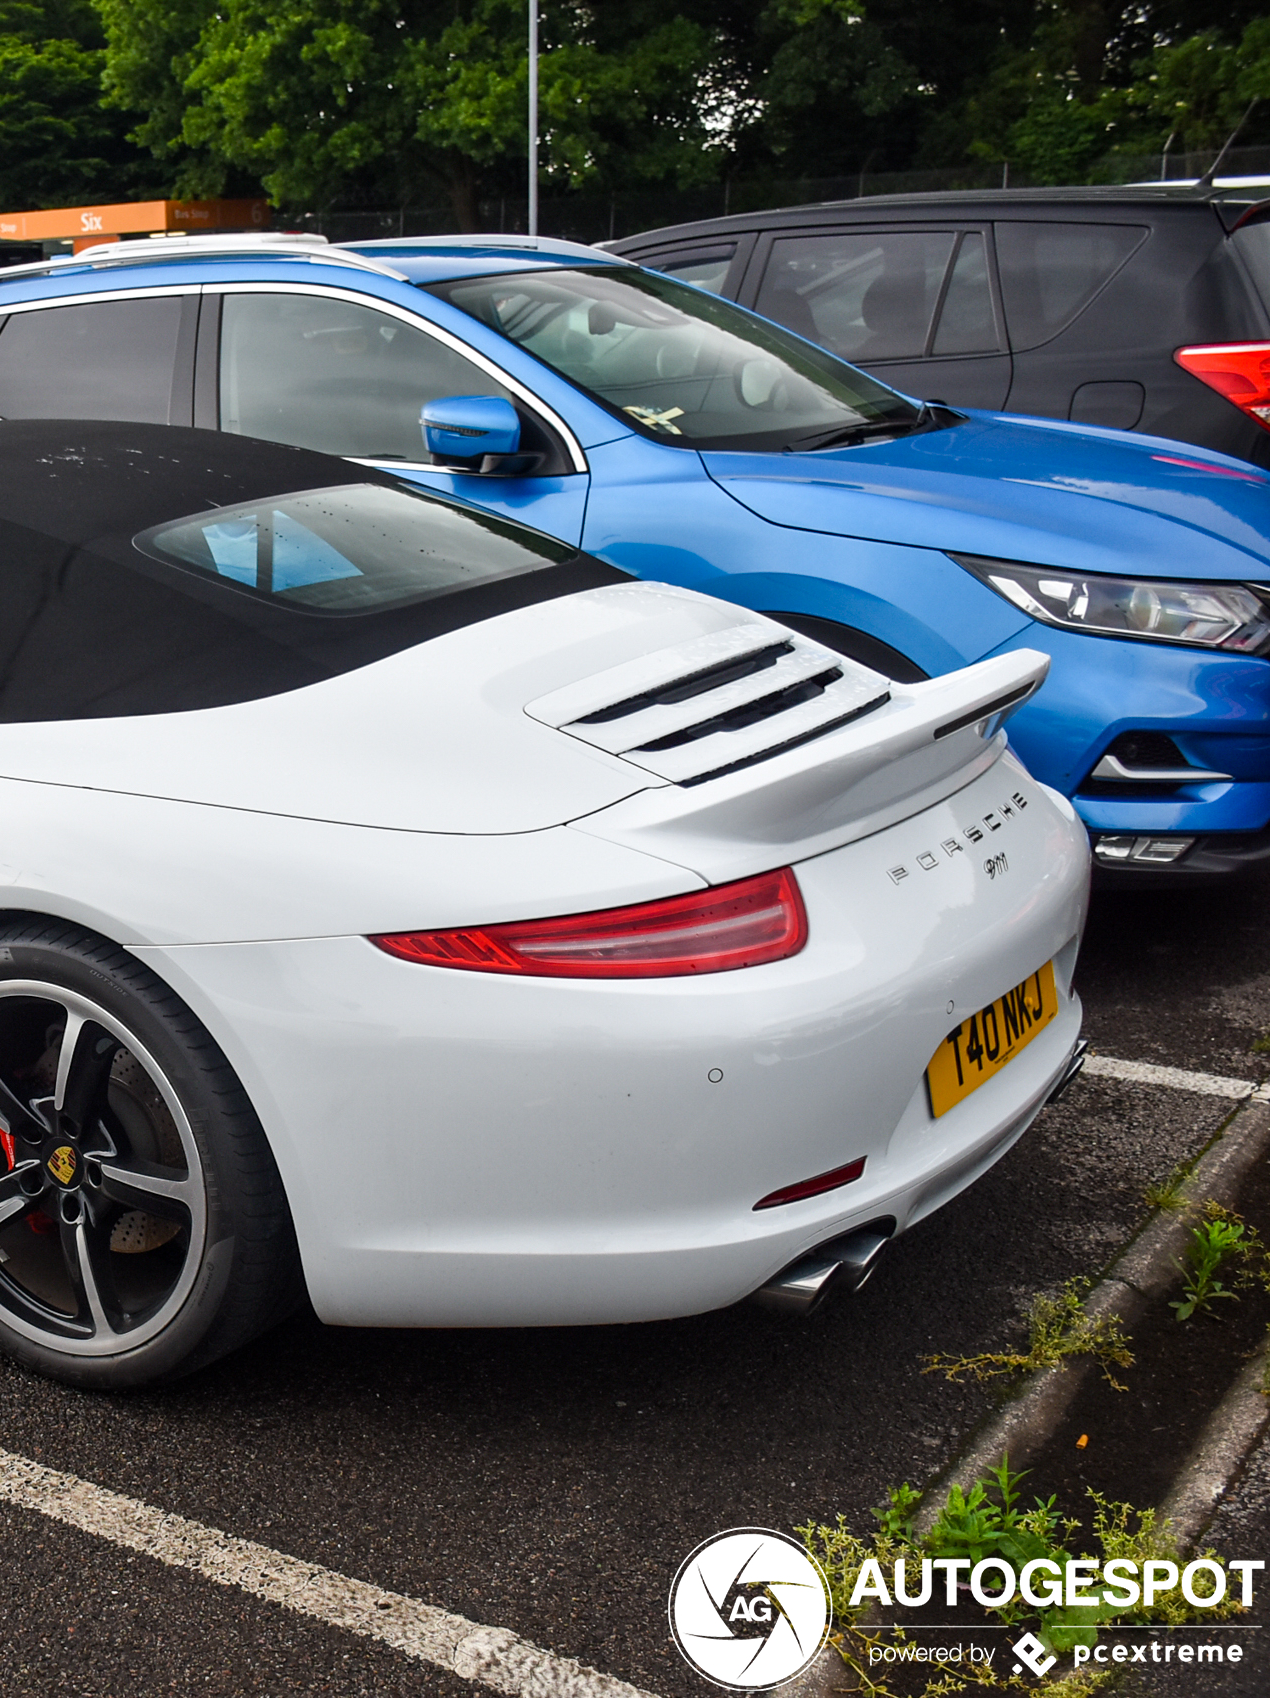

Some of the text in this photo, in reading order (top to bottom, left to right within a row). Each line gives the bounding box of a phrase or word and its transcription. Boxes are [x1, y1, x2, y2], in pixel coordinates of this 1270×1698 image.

[0, 223, 18, 234] Stop
[80, 213, 103, 232] Six
[886, 792, 1028, 885] PORSCHE
[983, 852, 1009, 880] 911
[946, 970, 1043, 1087] T40 NKJ
